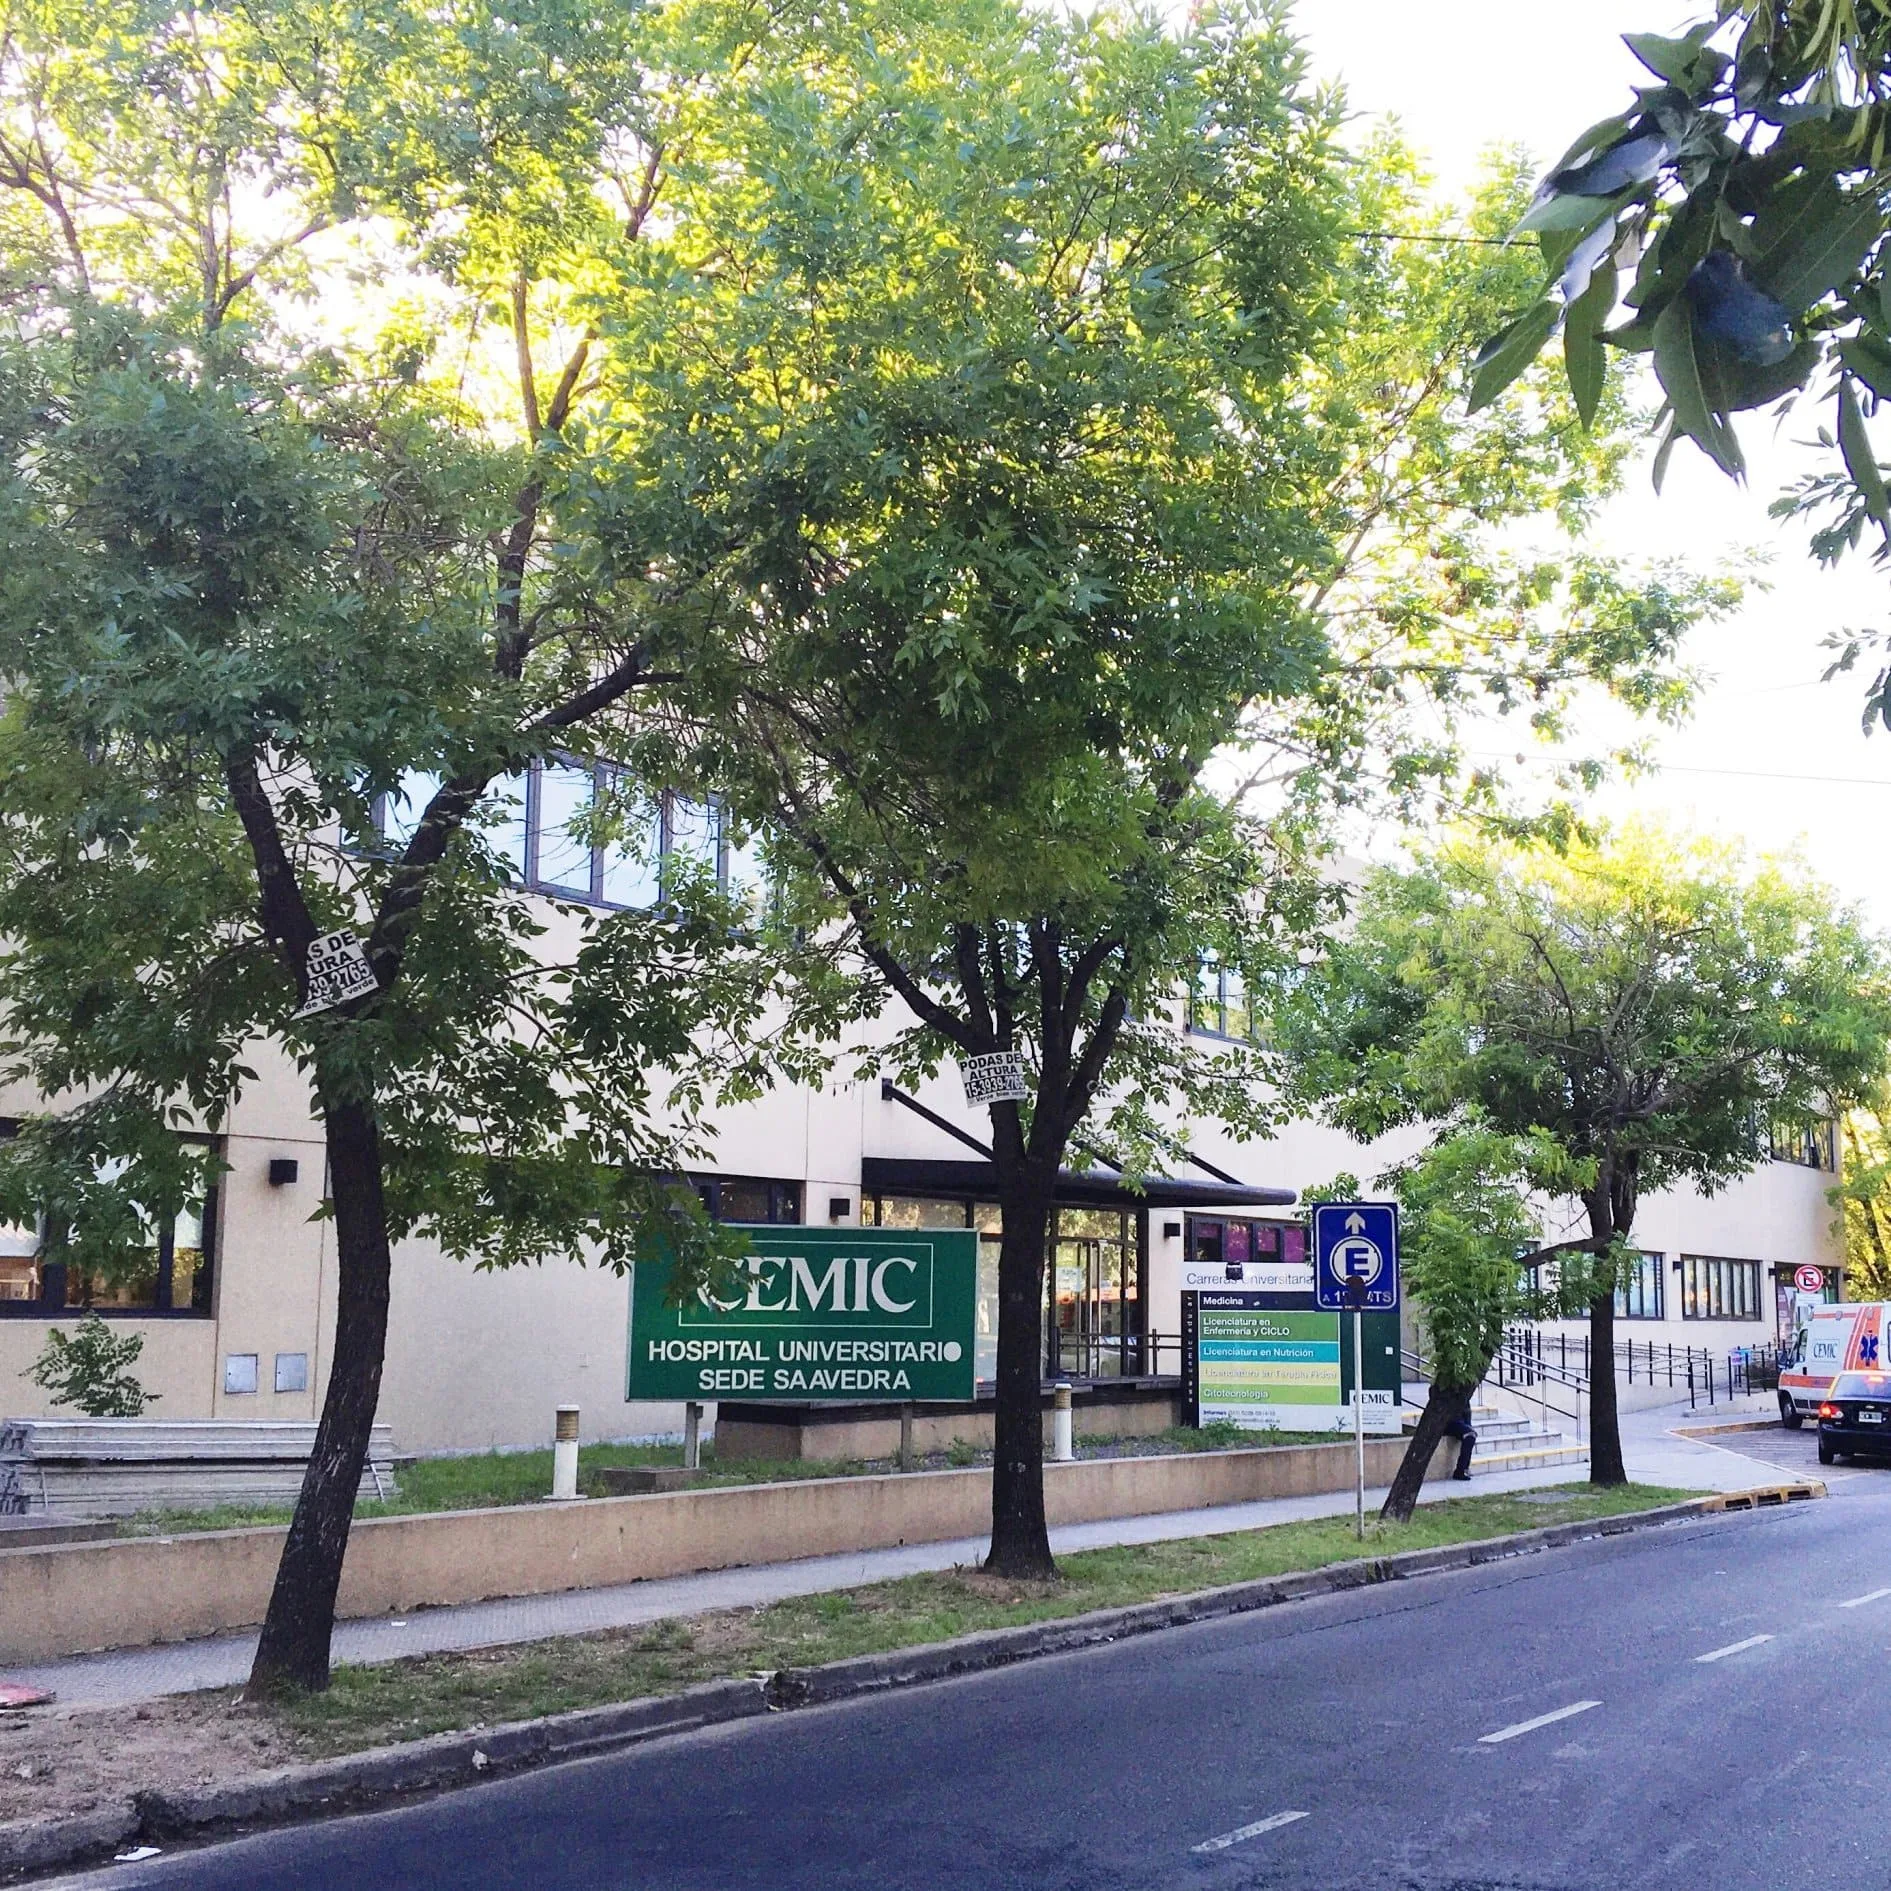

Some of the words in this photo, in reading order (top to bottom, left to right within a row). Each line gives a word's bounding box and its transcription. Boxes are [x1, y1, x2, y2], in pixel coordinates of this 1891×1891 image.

[328, 931, 356, 952] DE
[346, 978, 375, 994] verde
[960, 1054, 1003, 1072] PODAS
[1006, 1053, 1023, 1064] DE
[970, 1065, 1018, 1081] ALTURA
[966, 1074, 1025, 1098] 15-3939-2765
[1346, 1248, 1370, 1275] E
[1804, 1272, 1816, 1286] E
[1203, 1296, 1244, 1306] Medicina
[1323, 1294, 1330, 1302] A
[1203, 1317, 1257, 1326] Licenciatura
[1253, 1329, 1259, 1337] y
[1260, 1327, 1290, 1336] CICLO
[649, 1340, 770, 1362] HOSPITAL
[778, 1340, 962, 1363] UNIVERSITARIO
[1203, 1347, 1258, 1356] Licenciatura
[1813, 1343, 1837, 1359] CEMIC
[698, 1369, 765, 1390] SEDE
[773, 1369, 911, 1390] SAAVEDRA
